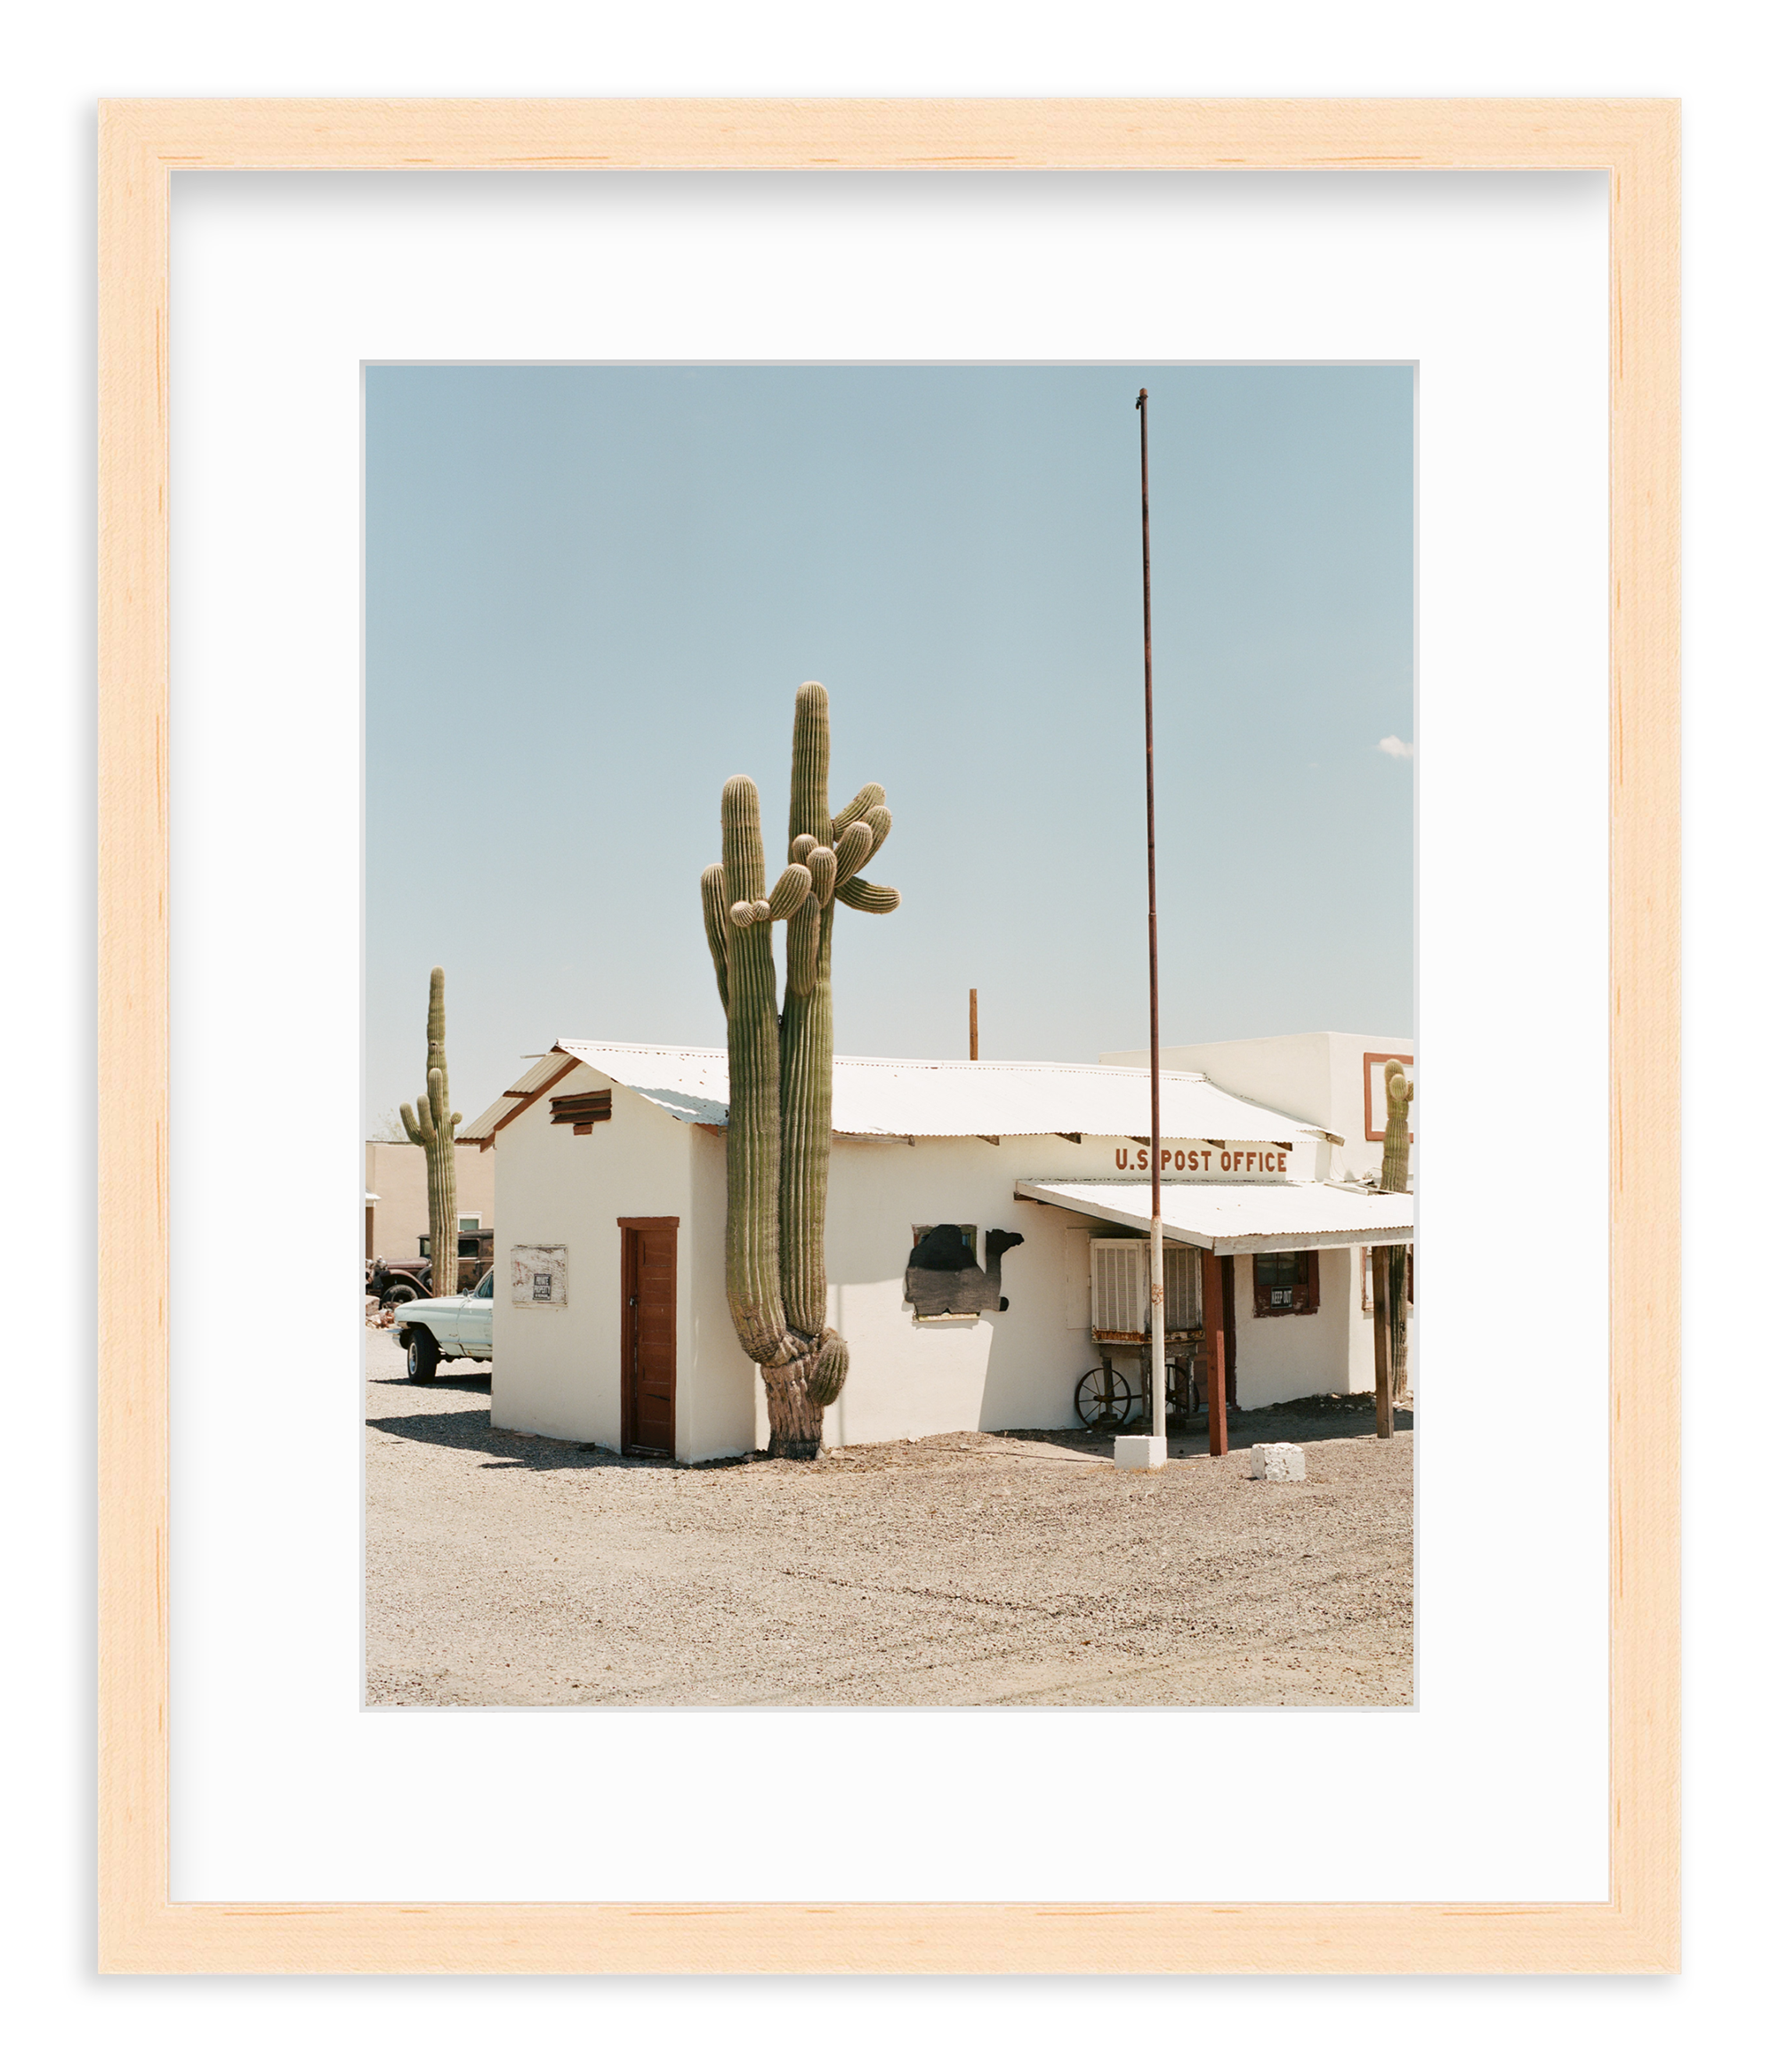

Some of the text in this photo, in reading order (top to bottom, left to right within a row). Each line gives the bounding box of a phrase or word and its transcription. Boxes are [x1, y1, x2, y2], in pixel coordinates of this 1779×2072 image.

[1115, 1149, 1286, 1172] U.S POST OFFICE
[1271, 1290, 1292, 1304] KEEP OUT
